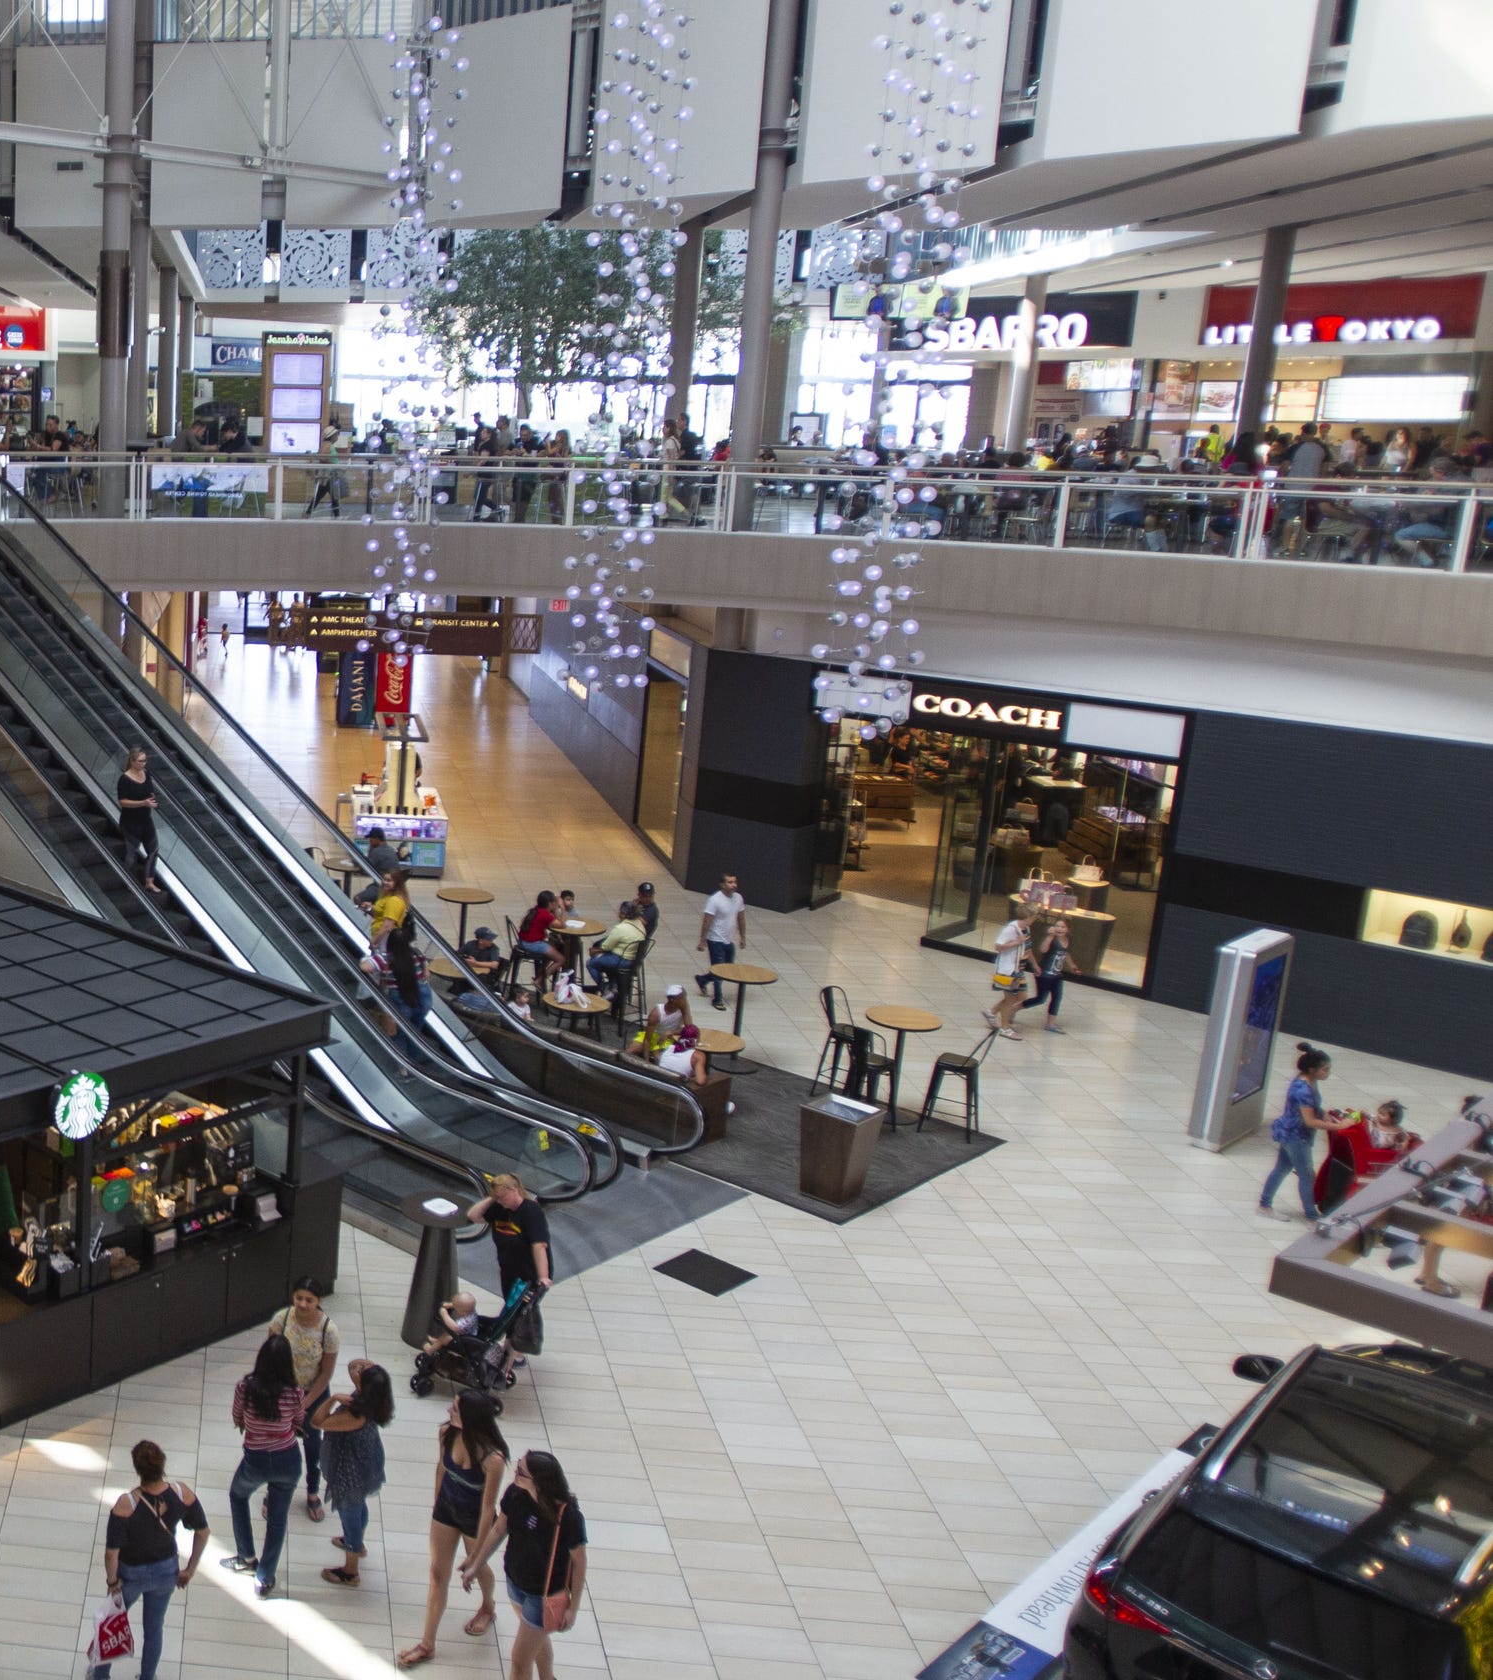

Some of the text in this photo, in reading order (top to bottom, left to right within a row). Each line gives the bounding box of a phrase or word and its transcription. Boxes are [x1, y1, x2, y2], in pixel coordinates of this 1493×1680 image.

[266, 334, 330, 345] Jamba Juice
[1204, 315, 1441, 345] LITLE TOKYO
[321, 629, 377, 637] AMPHITHEATER
[430, 619, 489, 628] RANSIT CENTER
[350, 661, 365, 711] DASANI
[912, 693, 1062, 730] COACH
[1017, 1555, 1093, 1630] Arrowhead
[102, 1624, 130, 1654] SBAR
